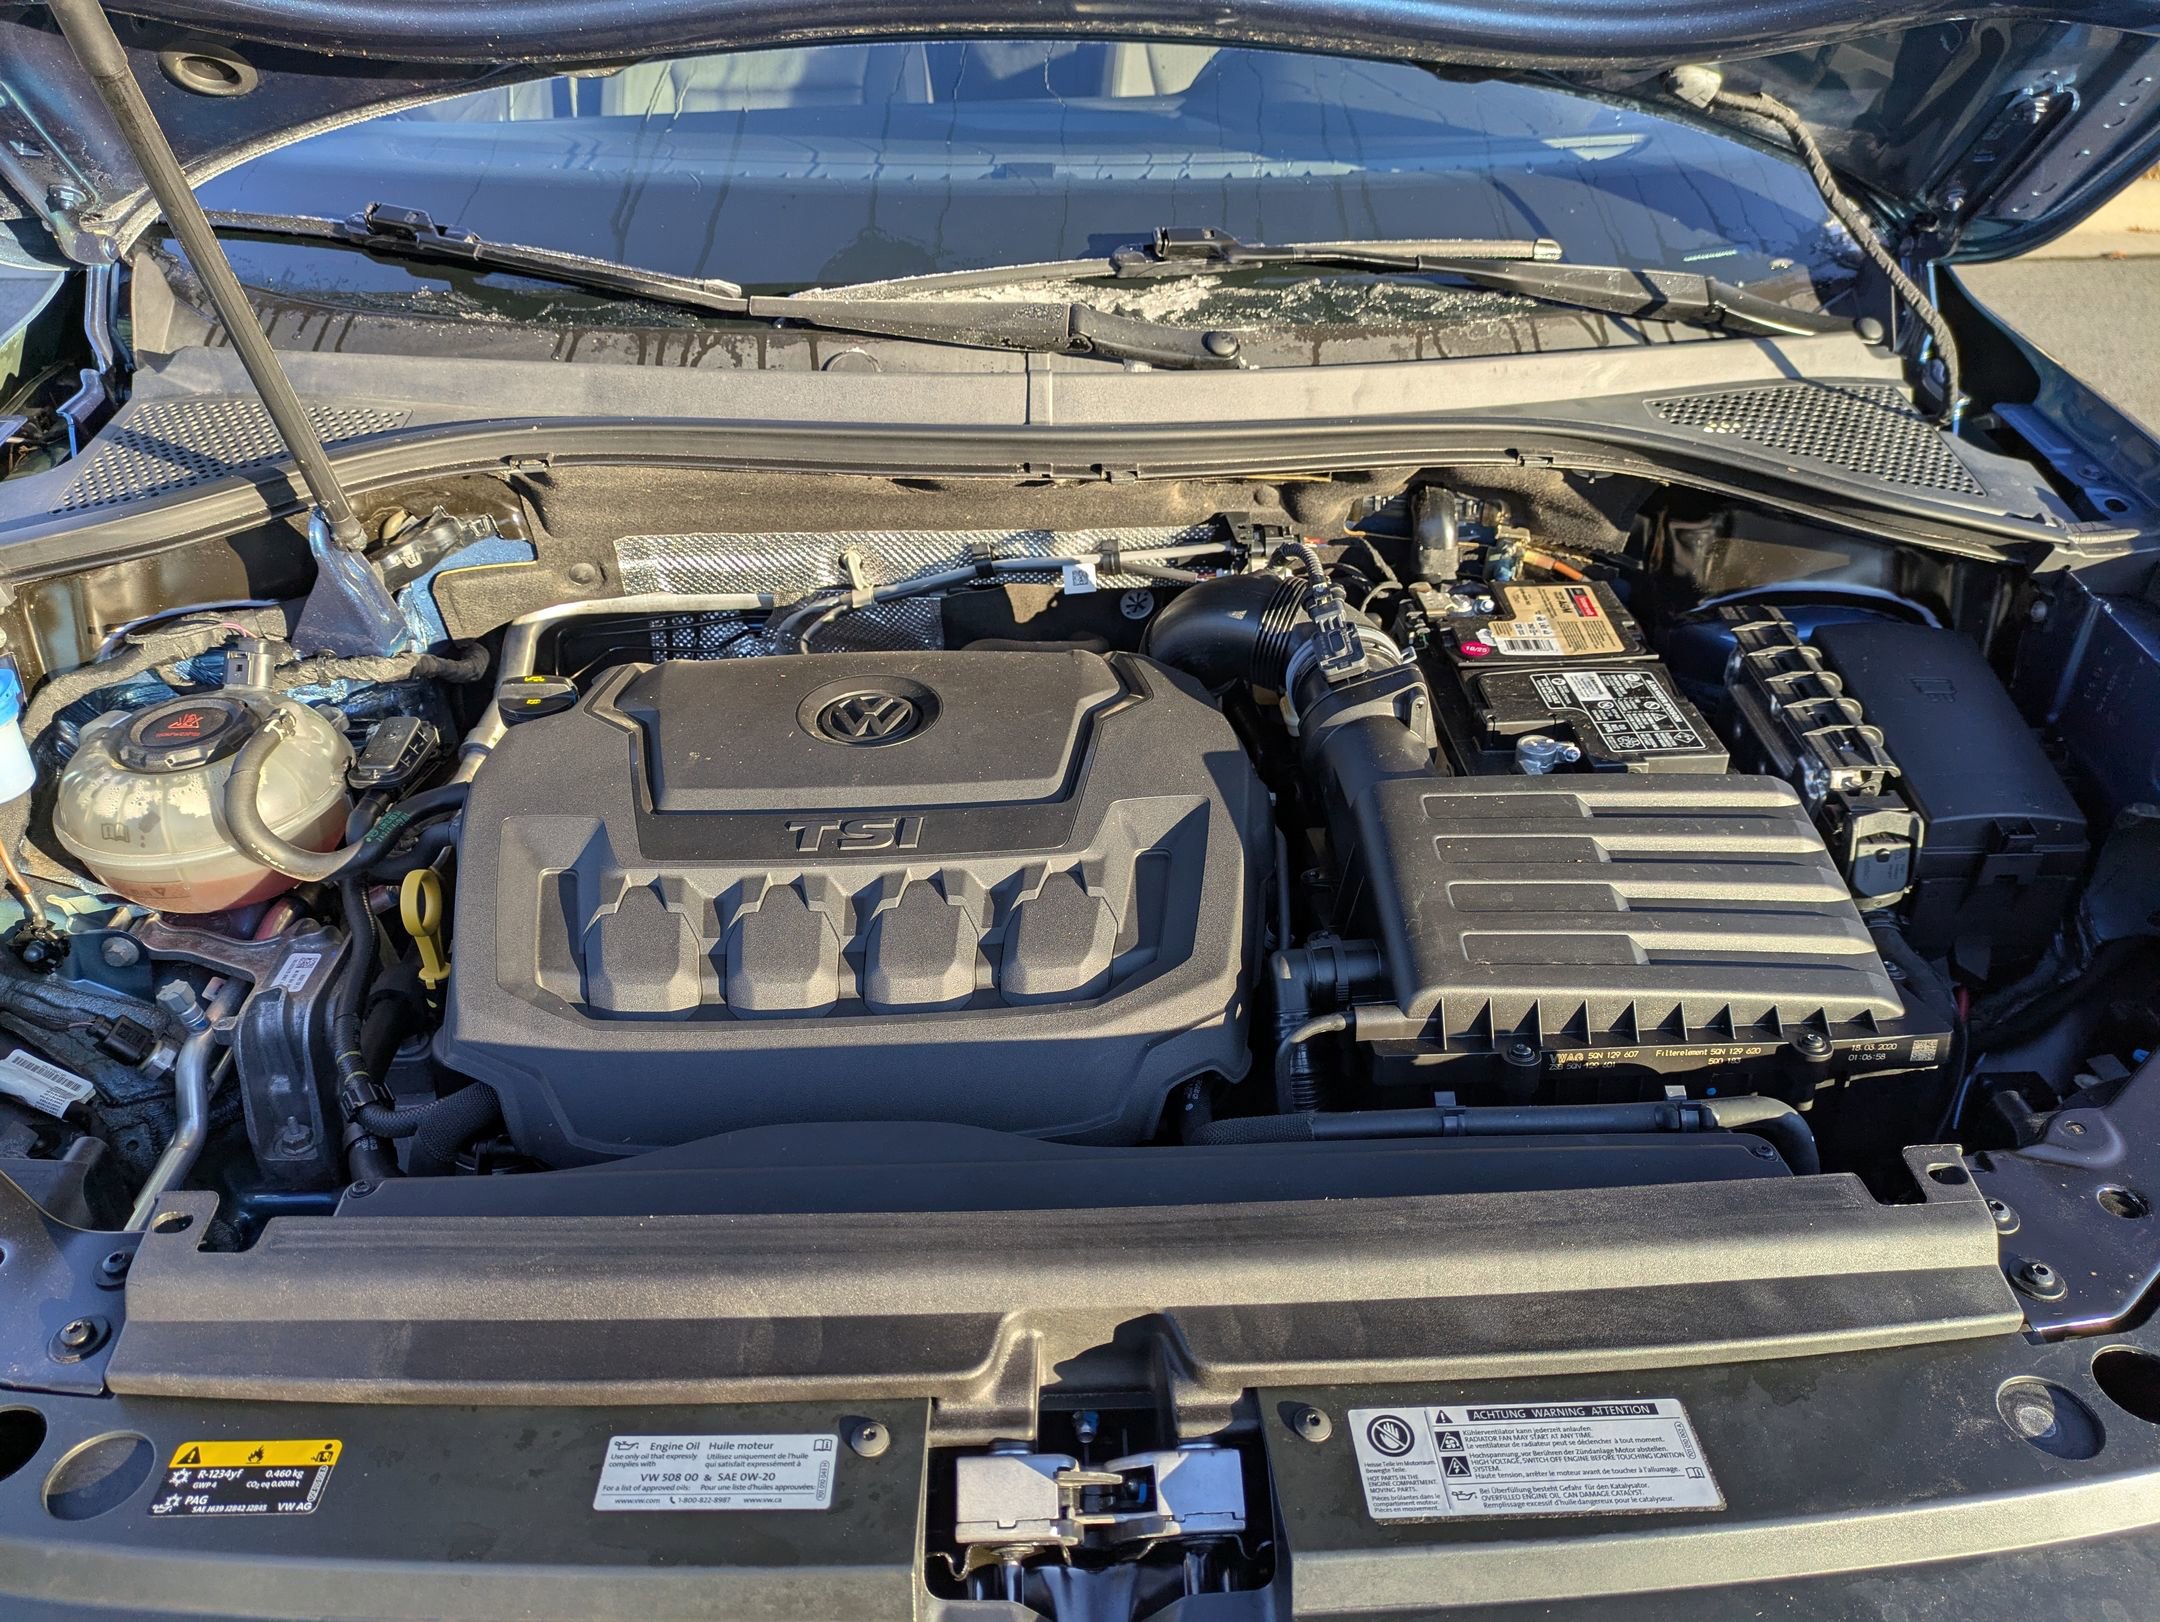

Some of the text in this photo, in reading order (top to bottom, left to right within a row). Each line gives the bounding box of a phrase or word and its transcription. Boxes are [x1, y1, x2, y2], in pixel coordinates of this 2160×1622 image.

[784, 816, 924, 852] TSI
[1607, 1050, 1639, 1059] 129 607
[1656, 1047, 1762, 1057] Filterelement 129 620
[1473, 1405, 1650, 1420] ACHTUNG WARNING ATTENTION
[1463, 1428, 1514, 1436] Kühlerventilator
[1534, 1427, 1560, 1435] jederzeit
[650, 1442, 700, 1452] Engine Oil
[709, 1442, 774, 1450] Huile moteur
[1553, 1440, 1568, 1448] peut
[666, 1453, 697, 1461] expressly
[734, 1453, 776, 1461] uniquement
[1469, 1451, 1520, 1460] Hochspannung,
[1576, 1448, 1614, 1456] Zündanlage
[705, 1461, 716, 1469] qui
[747, 1461, 795, 1469] expressément
[198, 1469, 244, 1480] R-1234yf
[265, 1470, 304, 1479] 0.460 kg
[1643, 1466, 1680, 1474] l'allumage.
[640, 1473, 776, 1482] VW 508 00 & SAE 0W-20
[1492, 1487, 1532, 1495] Überfüllung
[1610, 1483, 1650, 1491] Katalysator.
[184, 1496, 209, 1505] PAG
[1483, 1501, 1525, 1509] Remplissage
[1578, 1498, 1613, 1506] dangereux
[1639, 1496, 1675, 1504] catalyseur.
[278, 1503, 312, 1511] VW AG
